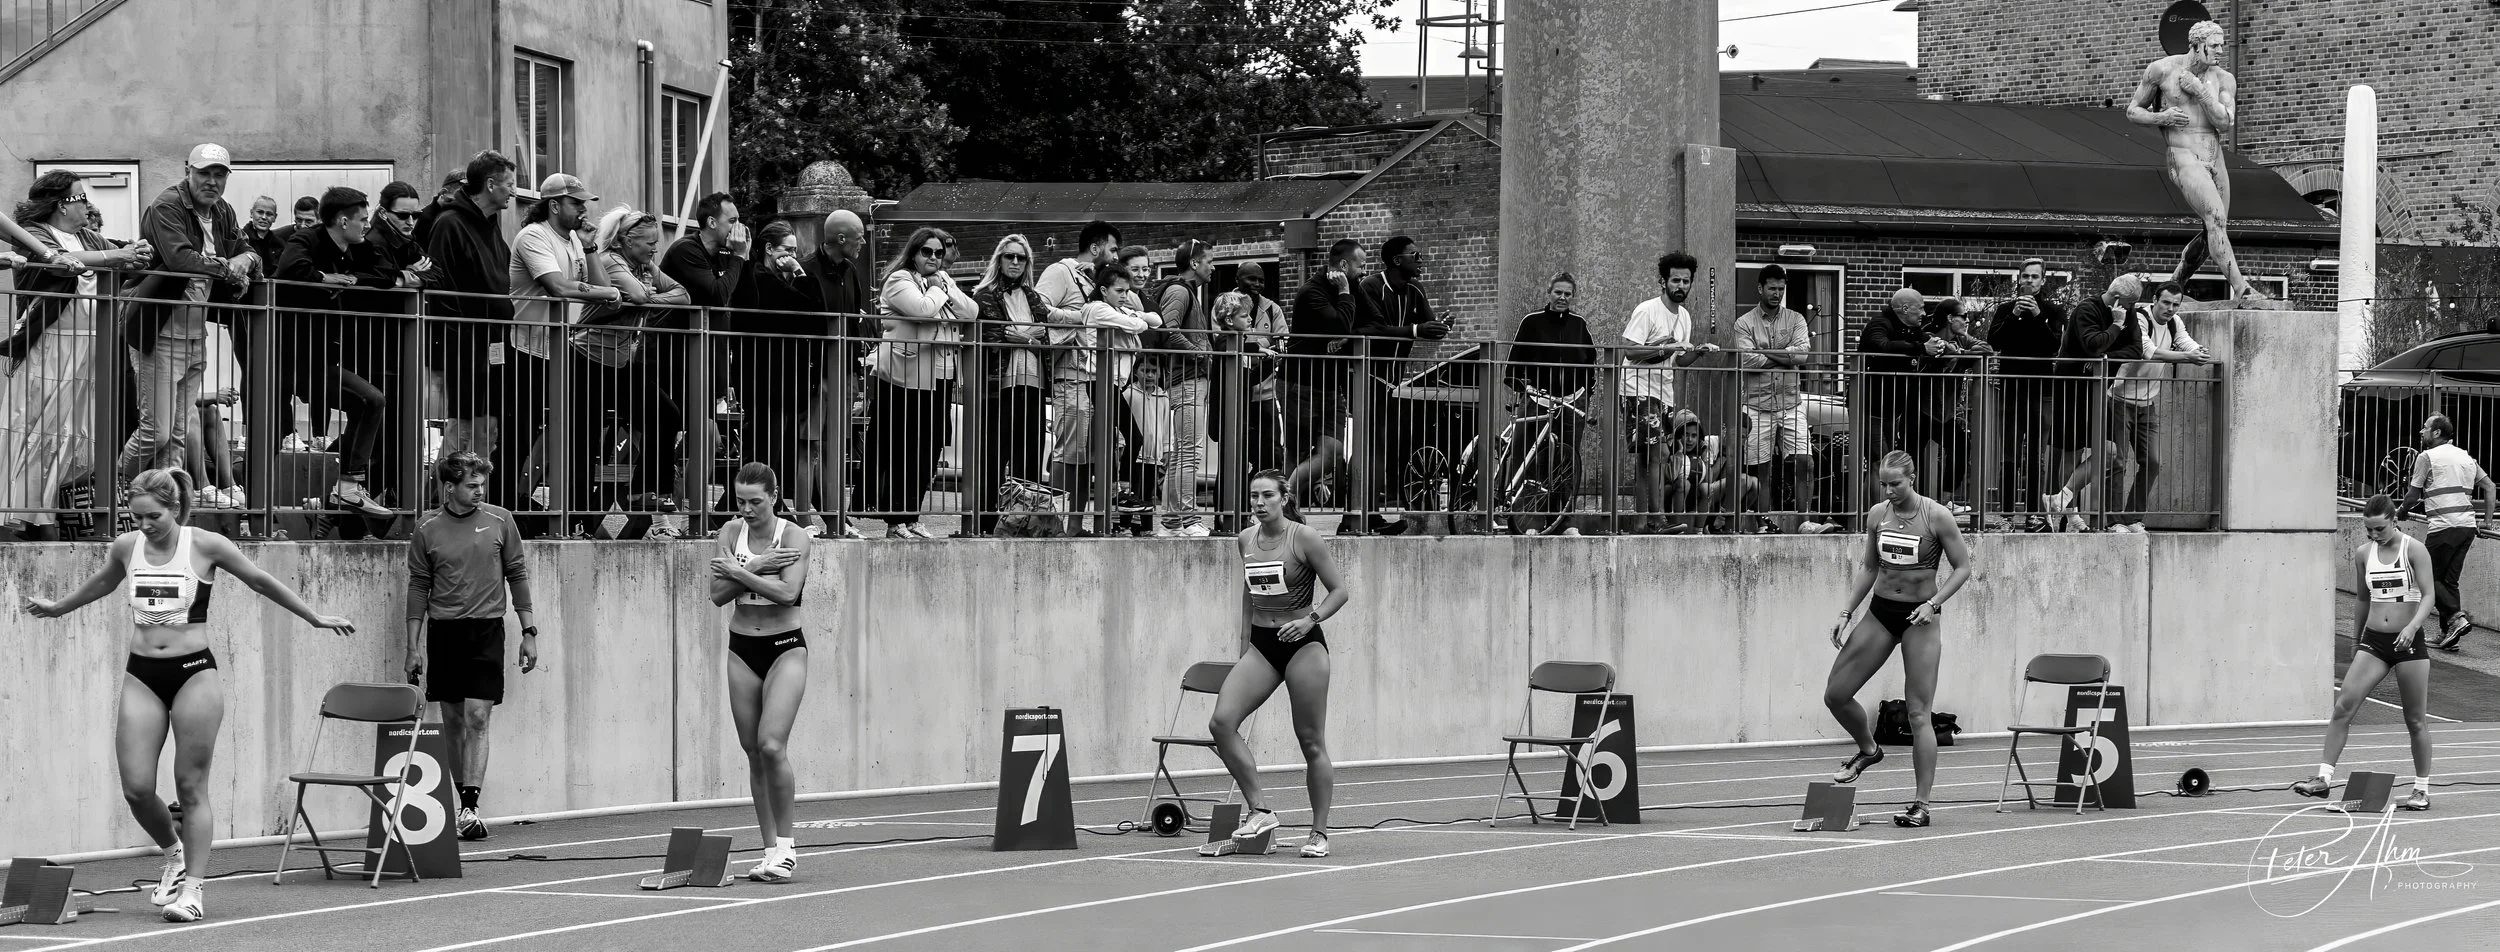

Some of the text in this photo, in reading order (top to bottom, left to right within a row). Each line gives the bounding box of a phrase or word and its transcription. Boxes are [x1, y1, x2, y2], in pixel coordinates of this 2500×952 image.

[150, 588, 161, 596] 79
[388, 728, 440, 736] nordicsrt.com
[1575, 719, 1627, 801] 6
[2070, 708, 2119, 787] 5
[381, 751, 446, 846] 8
[1011, 733, 1061, 826] 7
